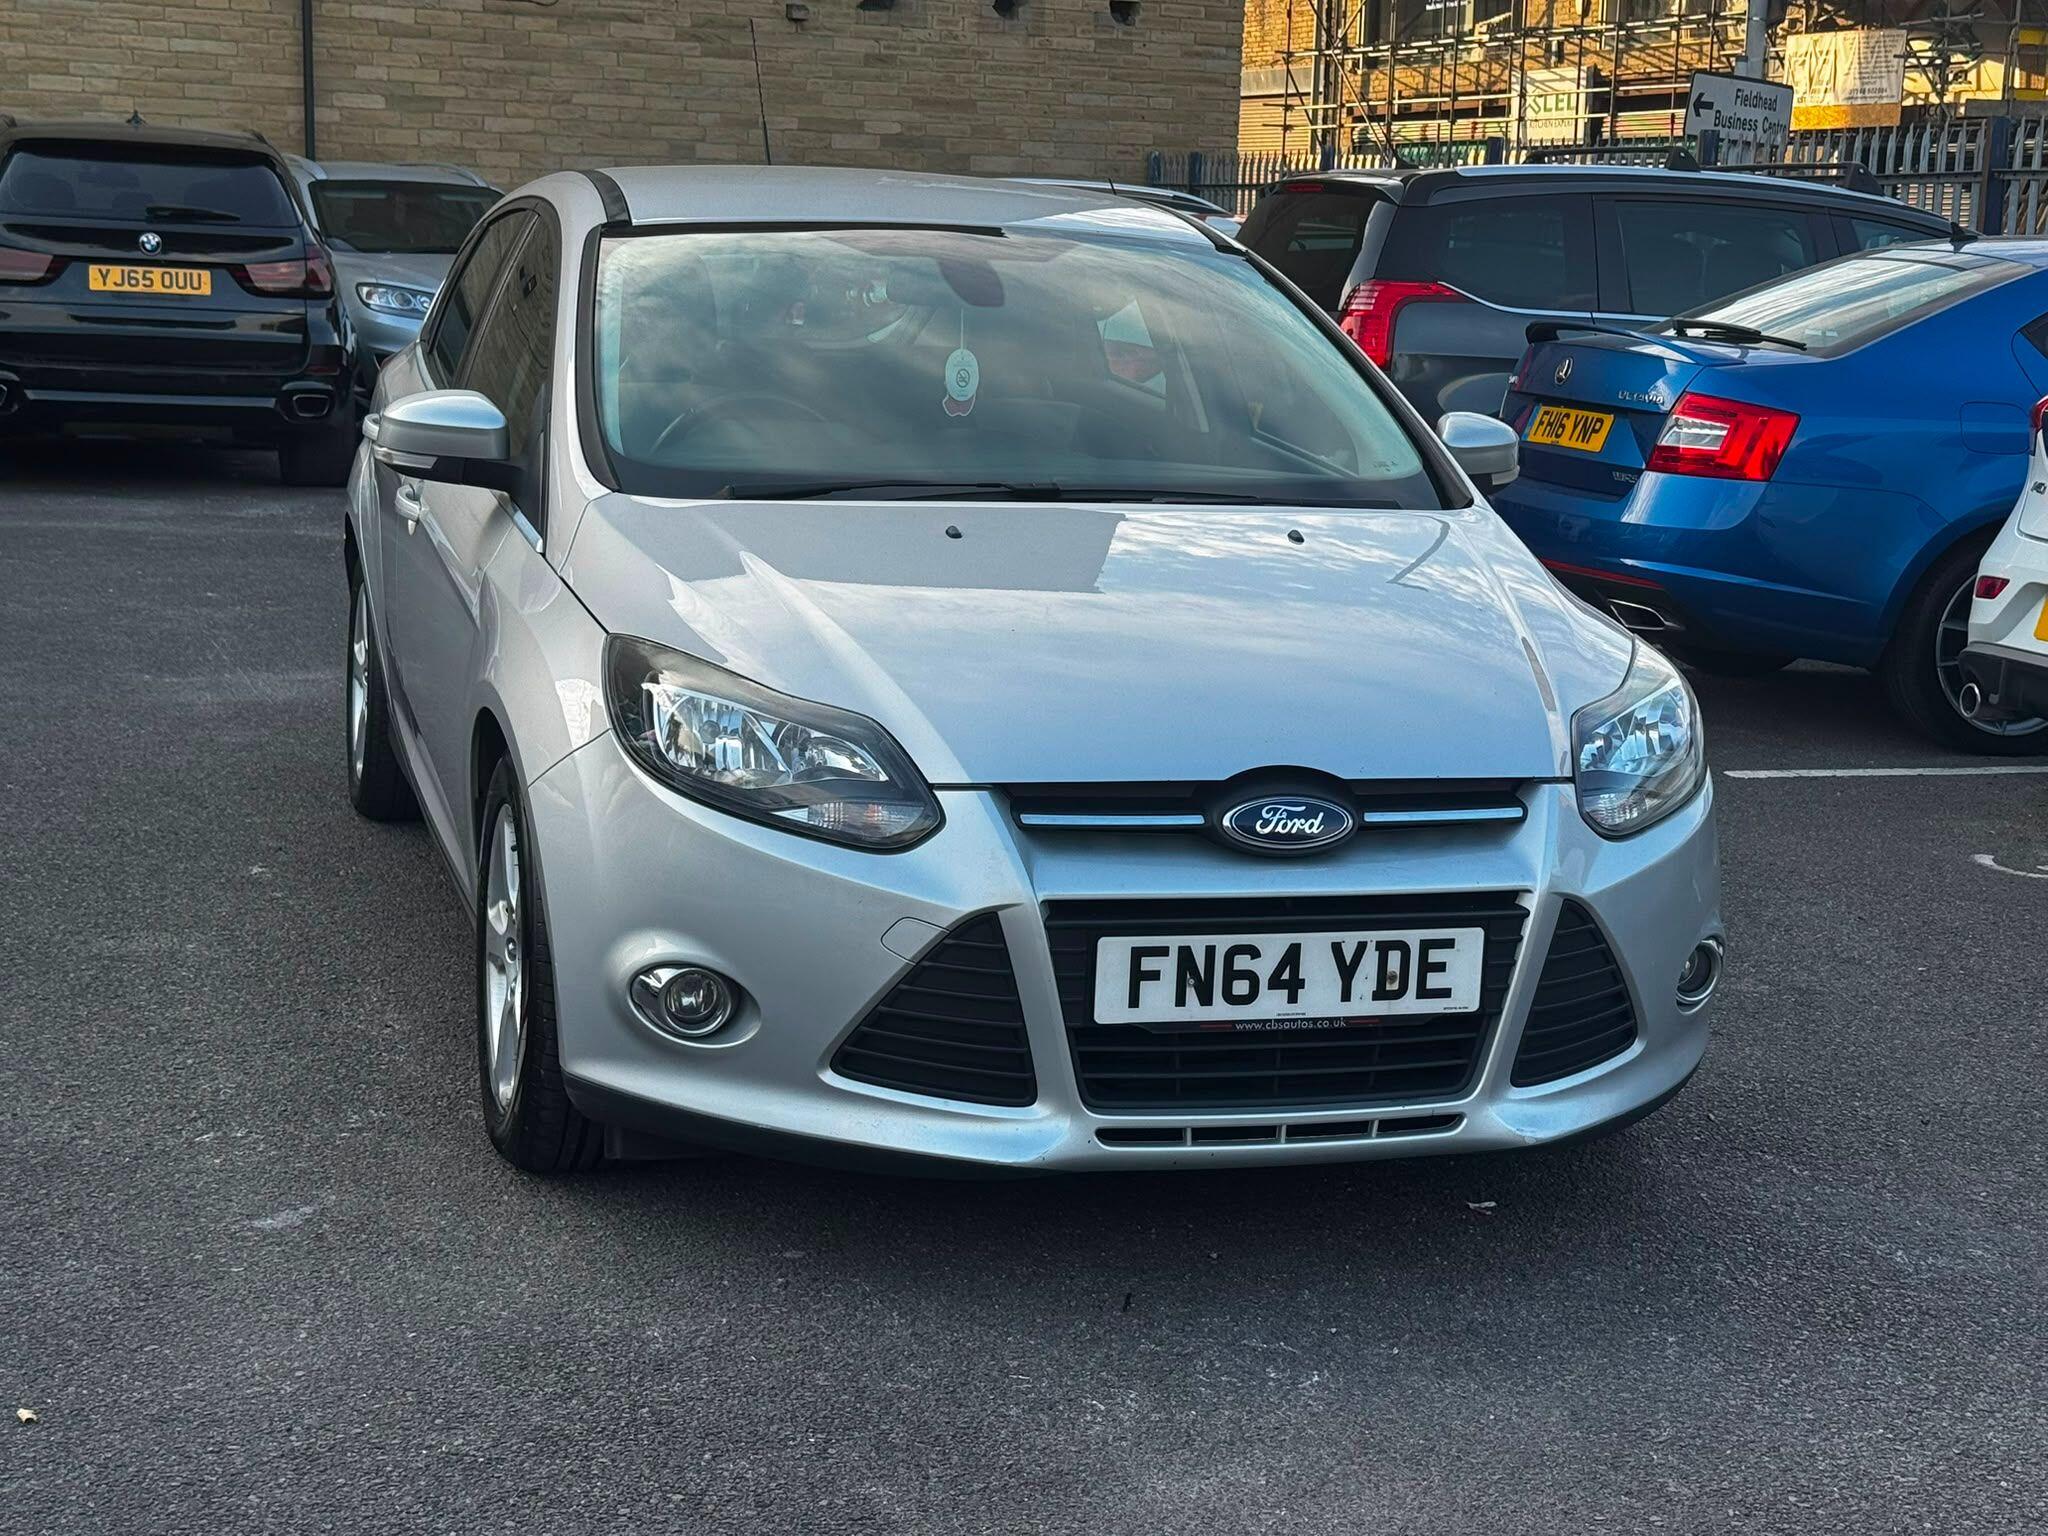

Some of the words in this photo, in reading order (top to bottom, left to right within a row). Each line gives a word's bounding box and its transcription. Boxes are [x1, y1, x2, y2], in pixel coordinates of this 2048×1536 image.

[1734, 88, 1778, 112] Fieldhead
[1713, 109, 1759, 132] Business
[98, 268, 154, 288] YJ65
[161, 271, 202, 291] OUU
[1533, 410, 1571, 439] FH16
[1568, 414, 1605, 445] YNP
[1255, 804, 1324, 835] Ford
[1127, 942, 1306, 1008] FN64
[1330, 938, 1456, 1003] YDE
[1235, 1017, 1347, 1031] www.cbsautos.co.uk
